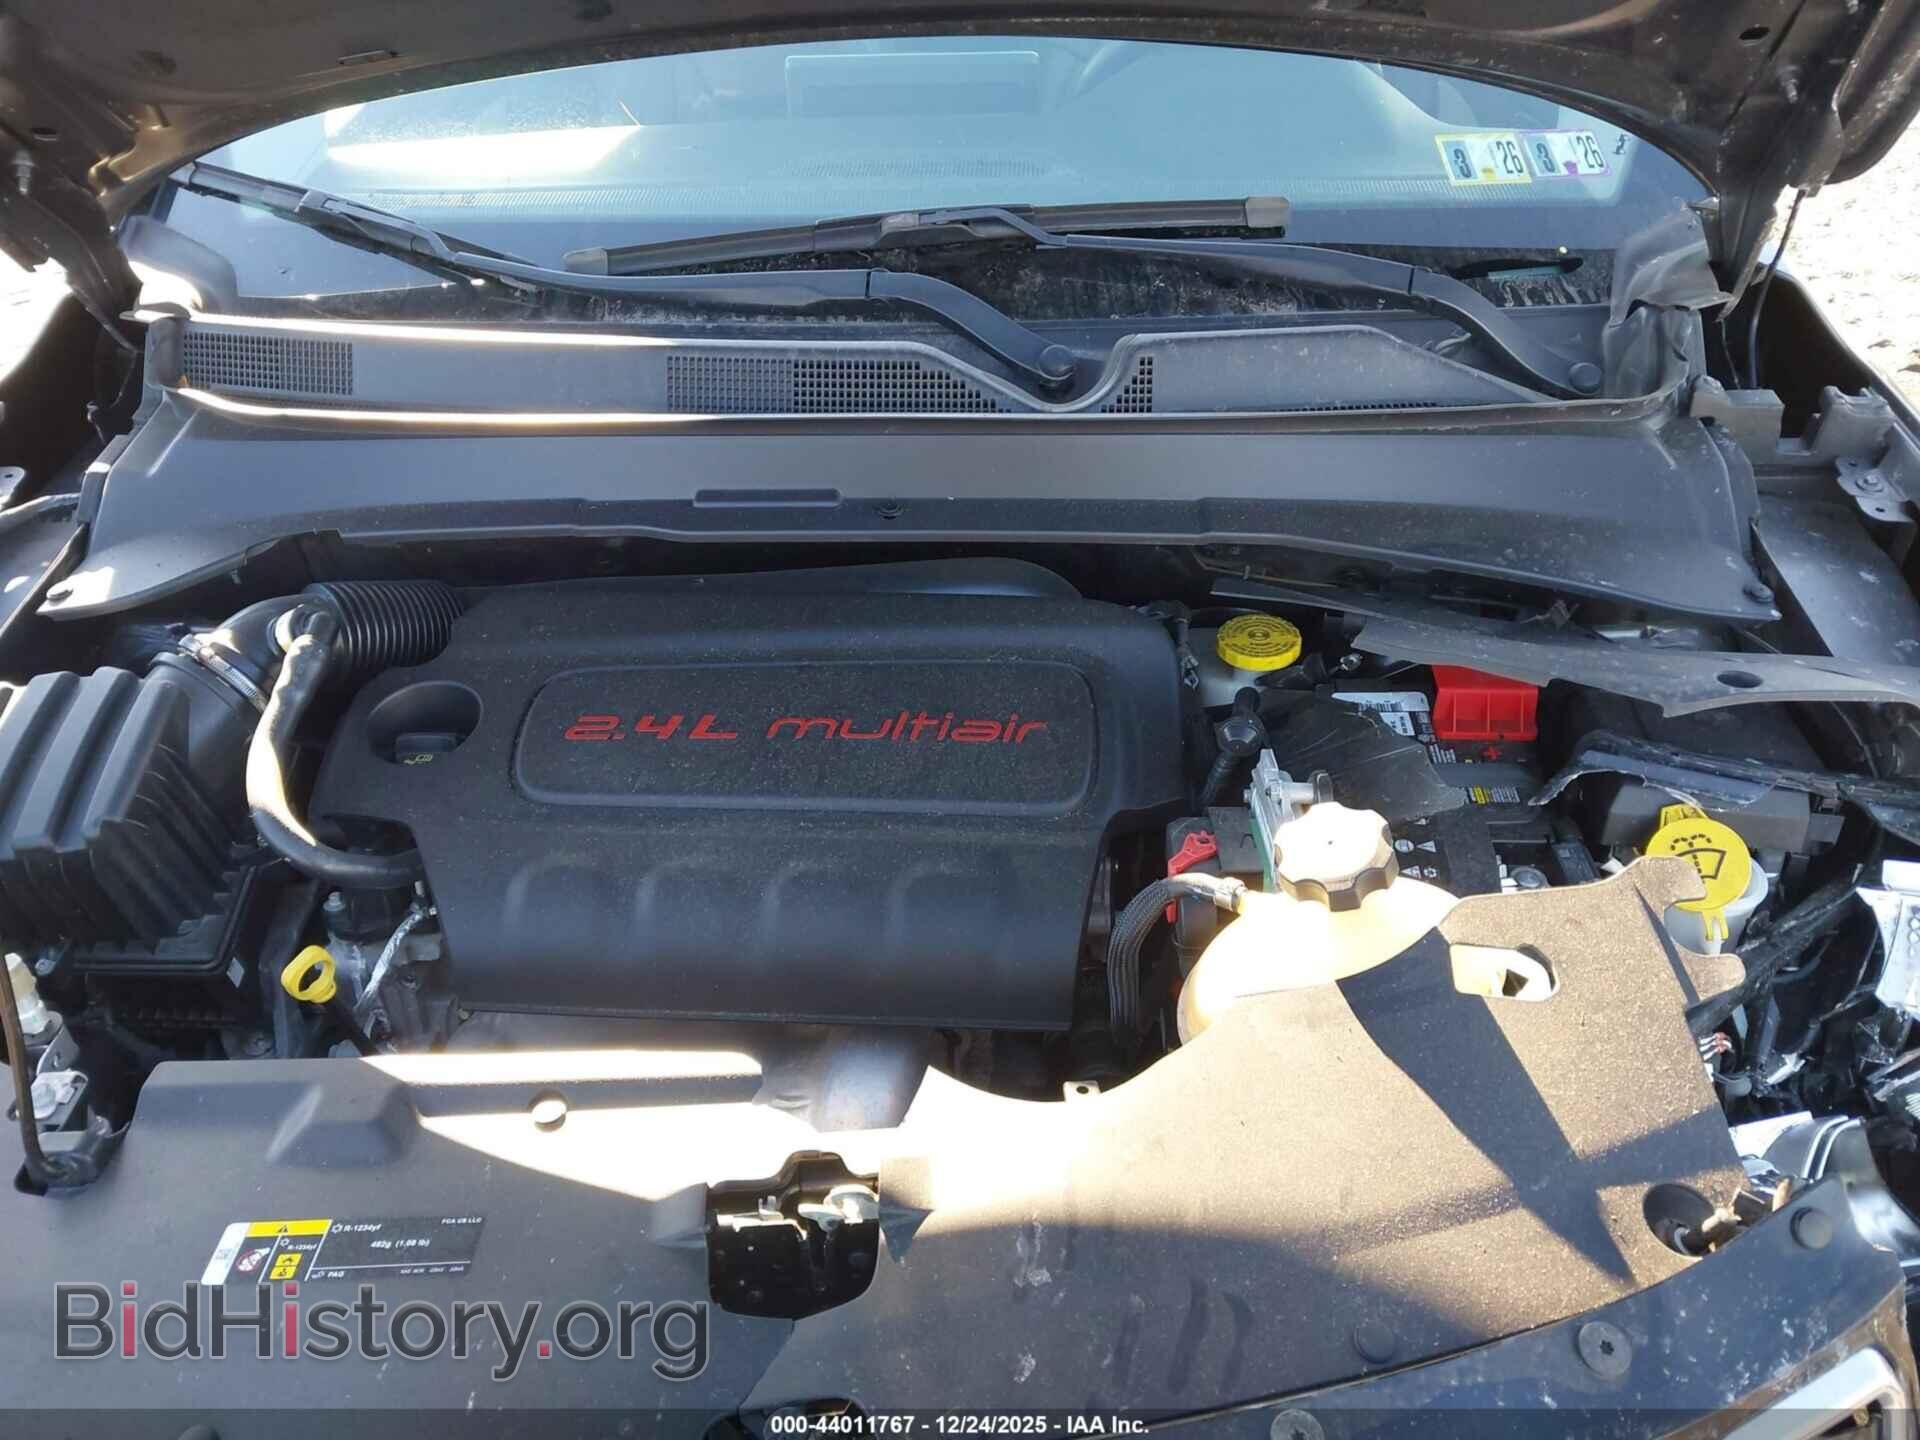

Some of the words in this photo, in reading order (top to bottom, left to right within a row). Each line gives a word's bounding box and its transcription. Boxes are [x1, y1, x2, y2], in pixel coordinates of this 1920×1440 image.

[1453, 148, 1472, 179] 3
[1496, 140, 1524, 175] 26
[1535, 142, 1556, 173] 3
[1576, 135, 1604, 169] 26
[766, 710, 1048, 744] multiair
